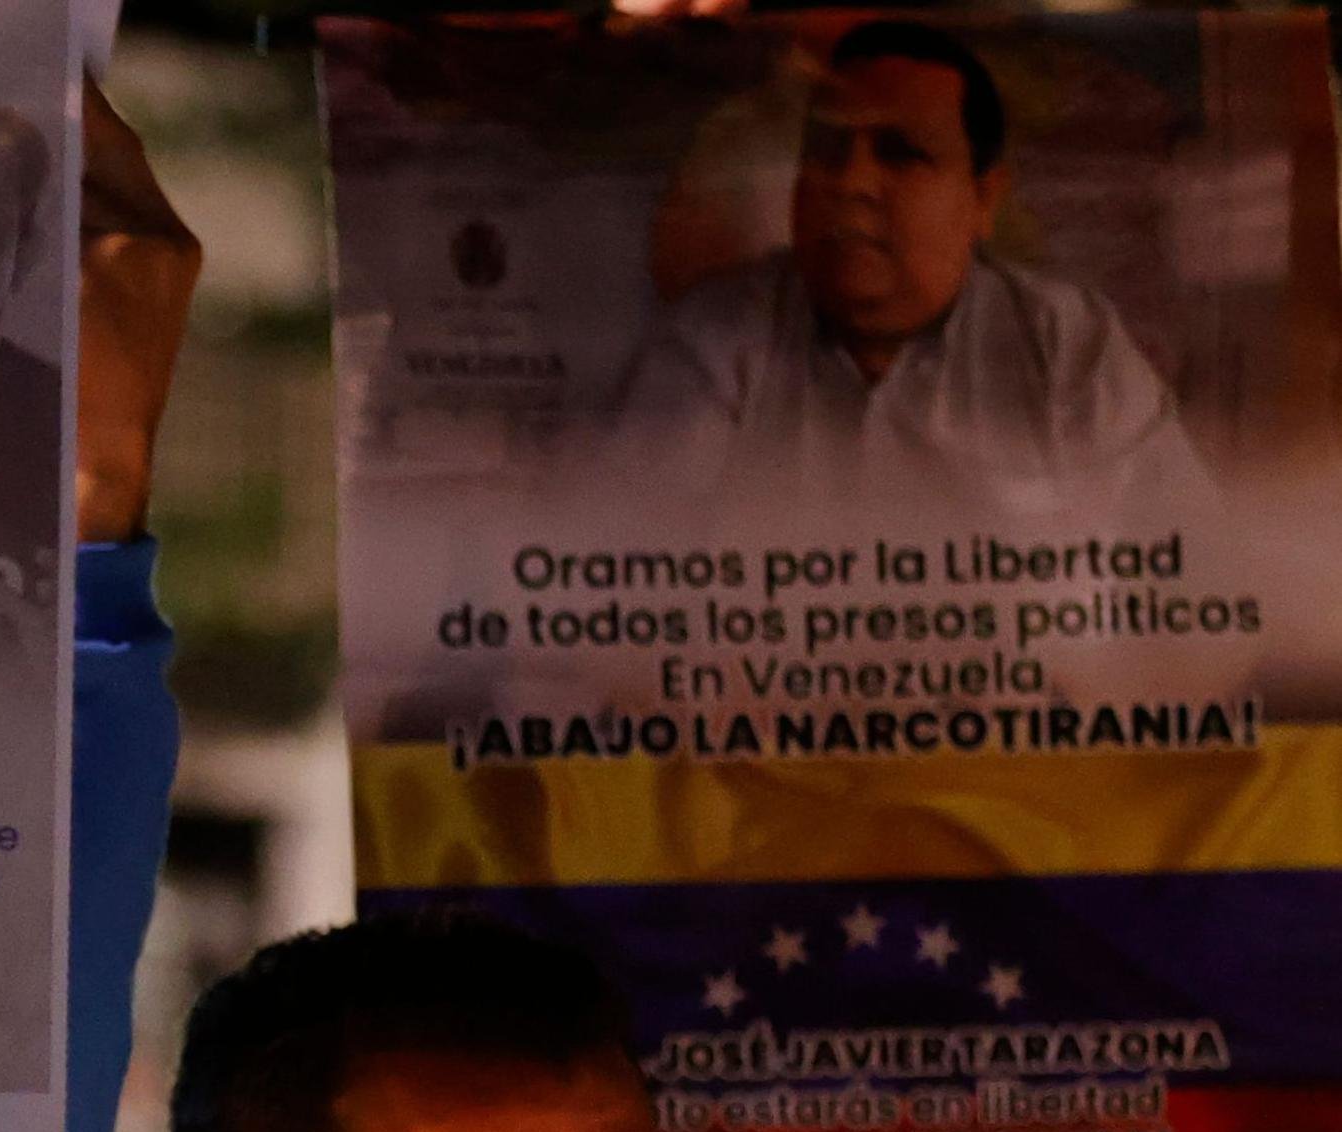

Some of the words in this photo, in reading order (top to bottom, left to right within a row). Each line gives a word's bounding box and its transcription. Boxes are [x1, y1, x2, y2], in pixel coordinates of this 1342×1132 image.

[513, 545, 746, 590] Oramos
[763, 546, 858, 598] por
[875, 538, 927, 585] la
[943, 533, 1183, 585] Libertad
[439, 603, 507, 650] de
[528, 599, 692, 649] todos
[706, 599, 786, 644] los
[805, 602, 997, 655] presos
[660, 657, 723, 699] En
[740, 652, 1044, 699] Venezuela
[453, 713, 678, 769] ¡ABAJO
[692, 711, 762, 759] LA
[776, 700, 1260, 755] NARCOTIRANIA!
[790, 1033, 951, 1075] JAVIER
[960, 1024, 1227, 1070] TARAZONA
[913, 1085, 969, 1122] en
[977, 1075, 1166, 1124] libertad
